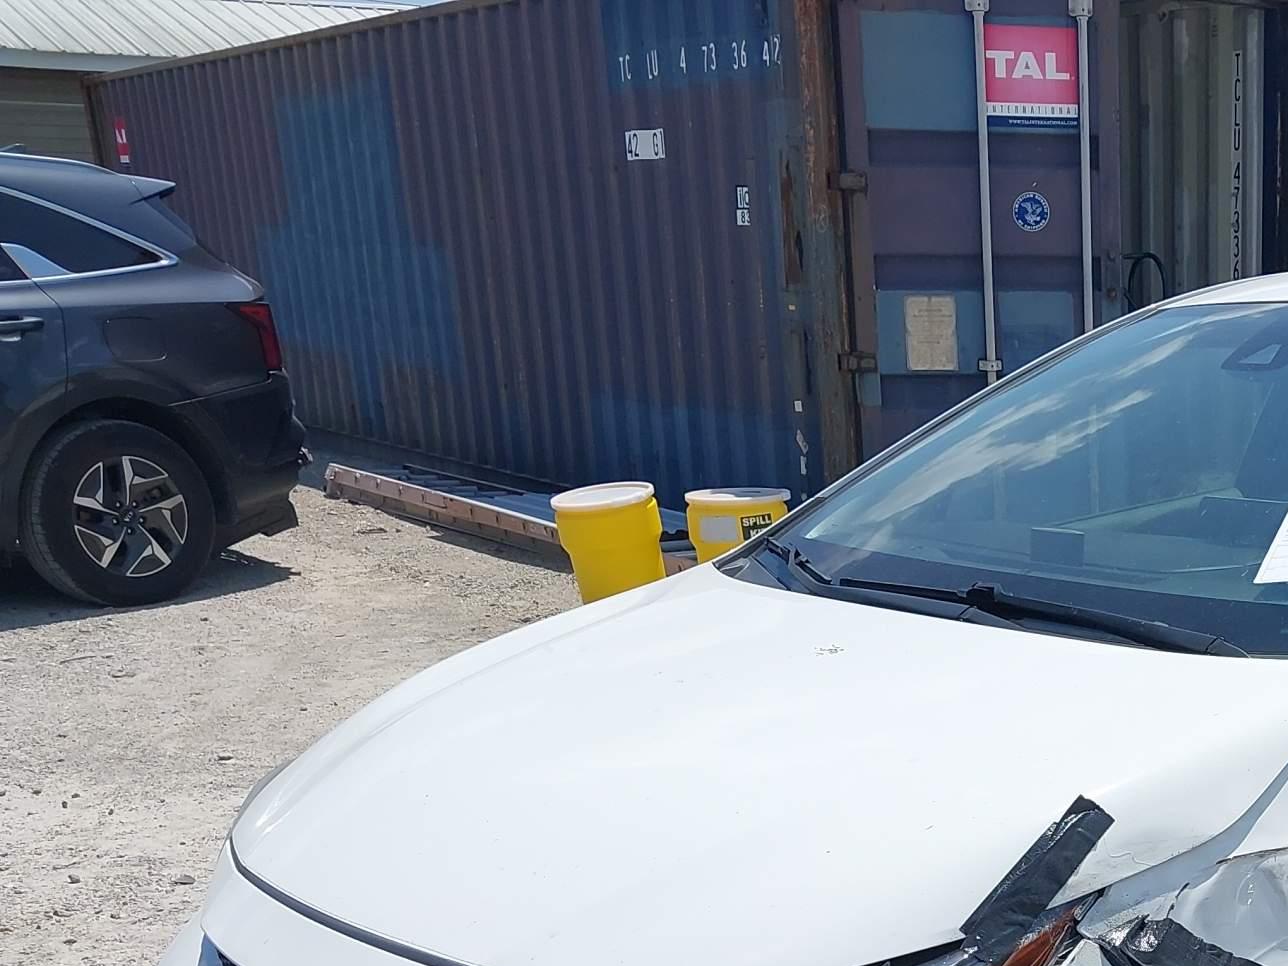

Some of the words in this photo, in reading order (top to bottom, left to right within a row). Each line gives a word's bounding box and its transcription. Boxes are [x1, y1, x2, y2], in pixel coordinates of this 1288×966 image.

[618, 53, 632, 83] TC
[646, 49, 659, 80] LU
[679, 46, 687, 75] 4
[701, 43, 717, 73] 73
[731, 39, 747, 70] 36
[742, 515, 771, 527] SPILL
